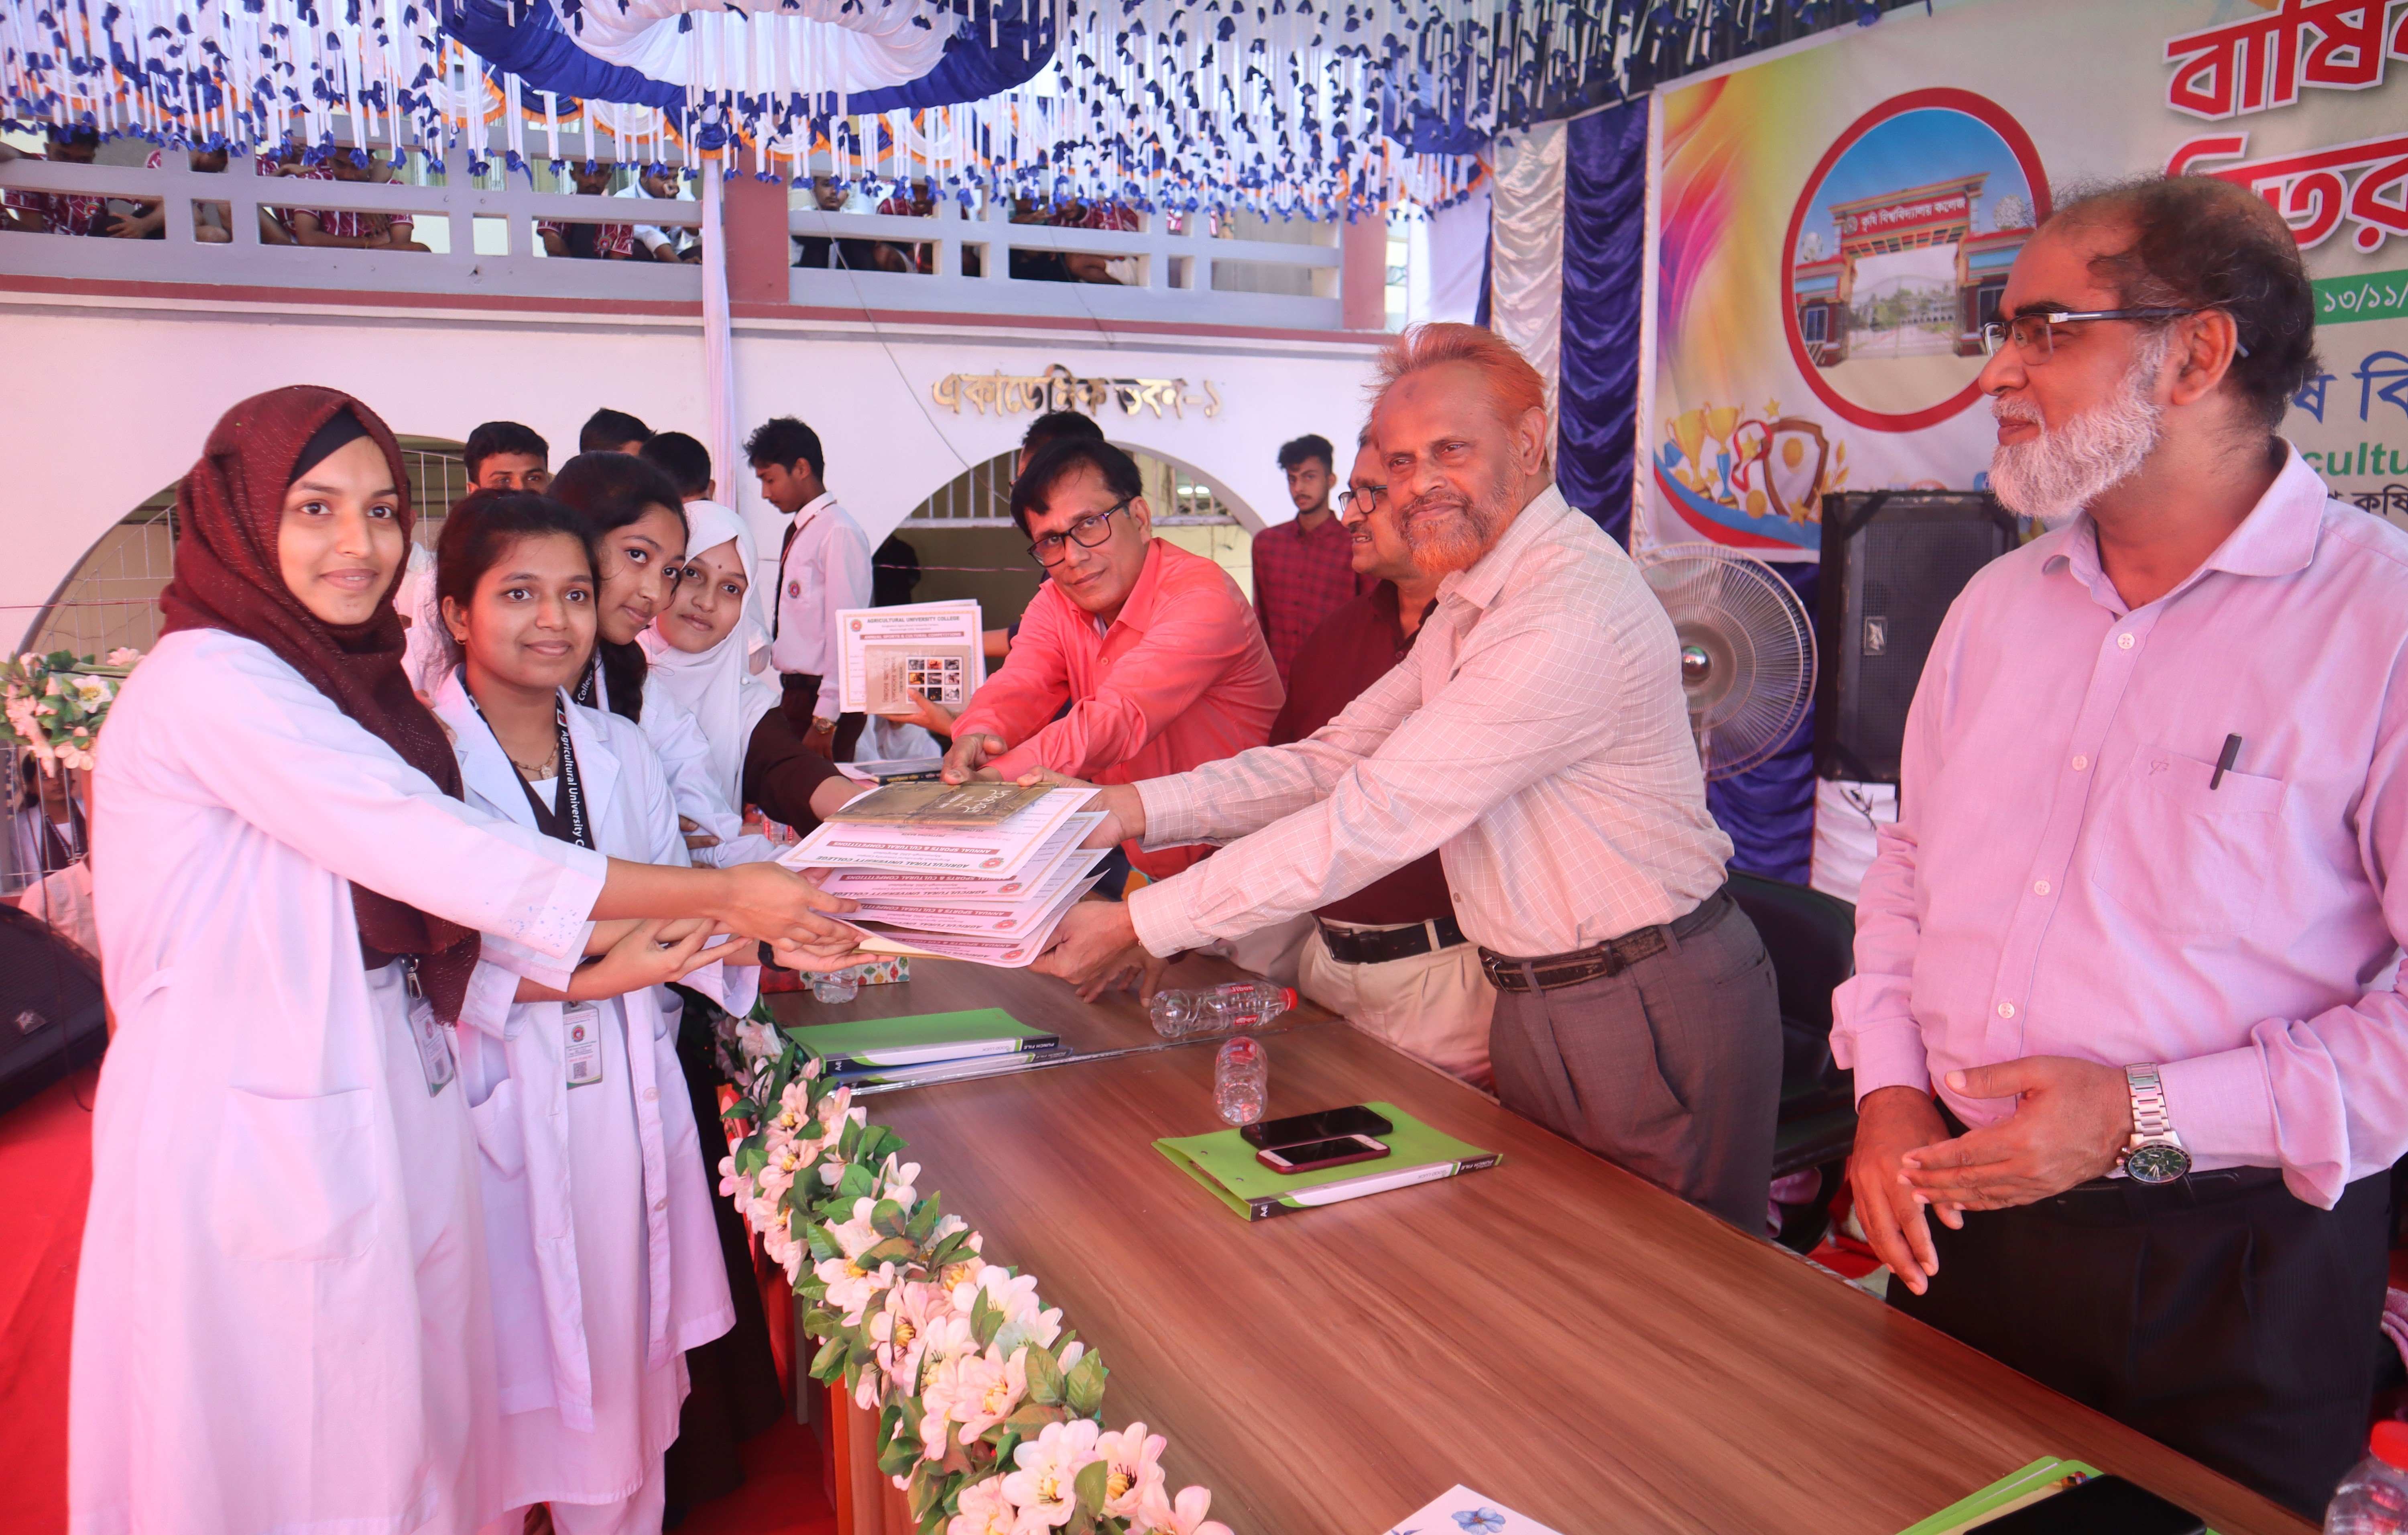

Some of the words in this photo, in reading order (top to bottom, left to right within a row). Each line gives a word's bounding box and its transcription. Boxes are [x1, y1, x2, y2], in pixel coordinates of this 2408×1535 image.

[932, 363, 1108, 417] একাডেমিক
[2302, 442, 2408, 476] cultu
[578, 670, 593, 701] Colleg
[561, 730, 577, 785] Agricultural
[568, 788, 583, 837] University
[834, 1061, 842, 1071] A4
[1260, 1205, 1268, 1217] A4
